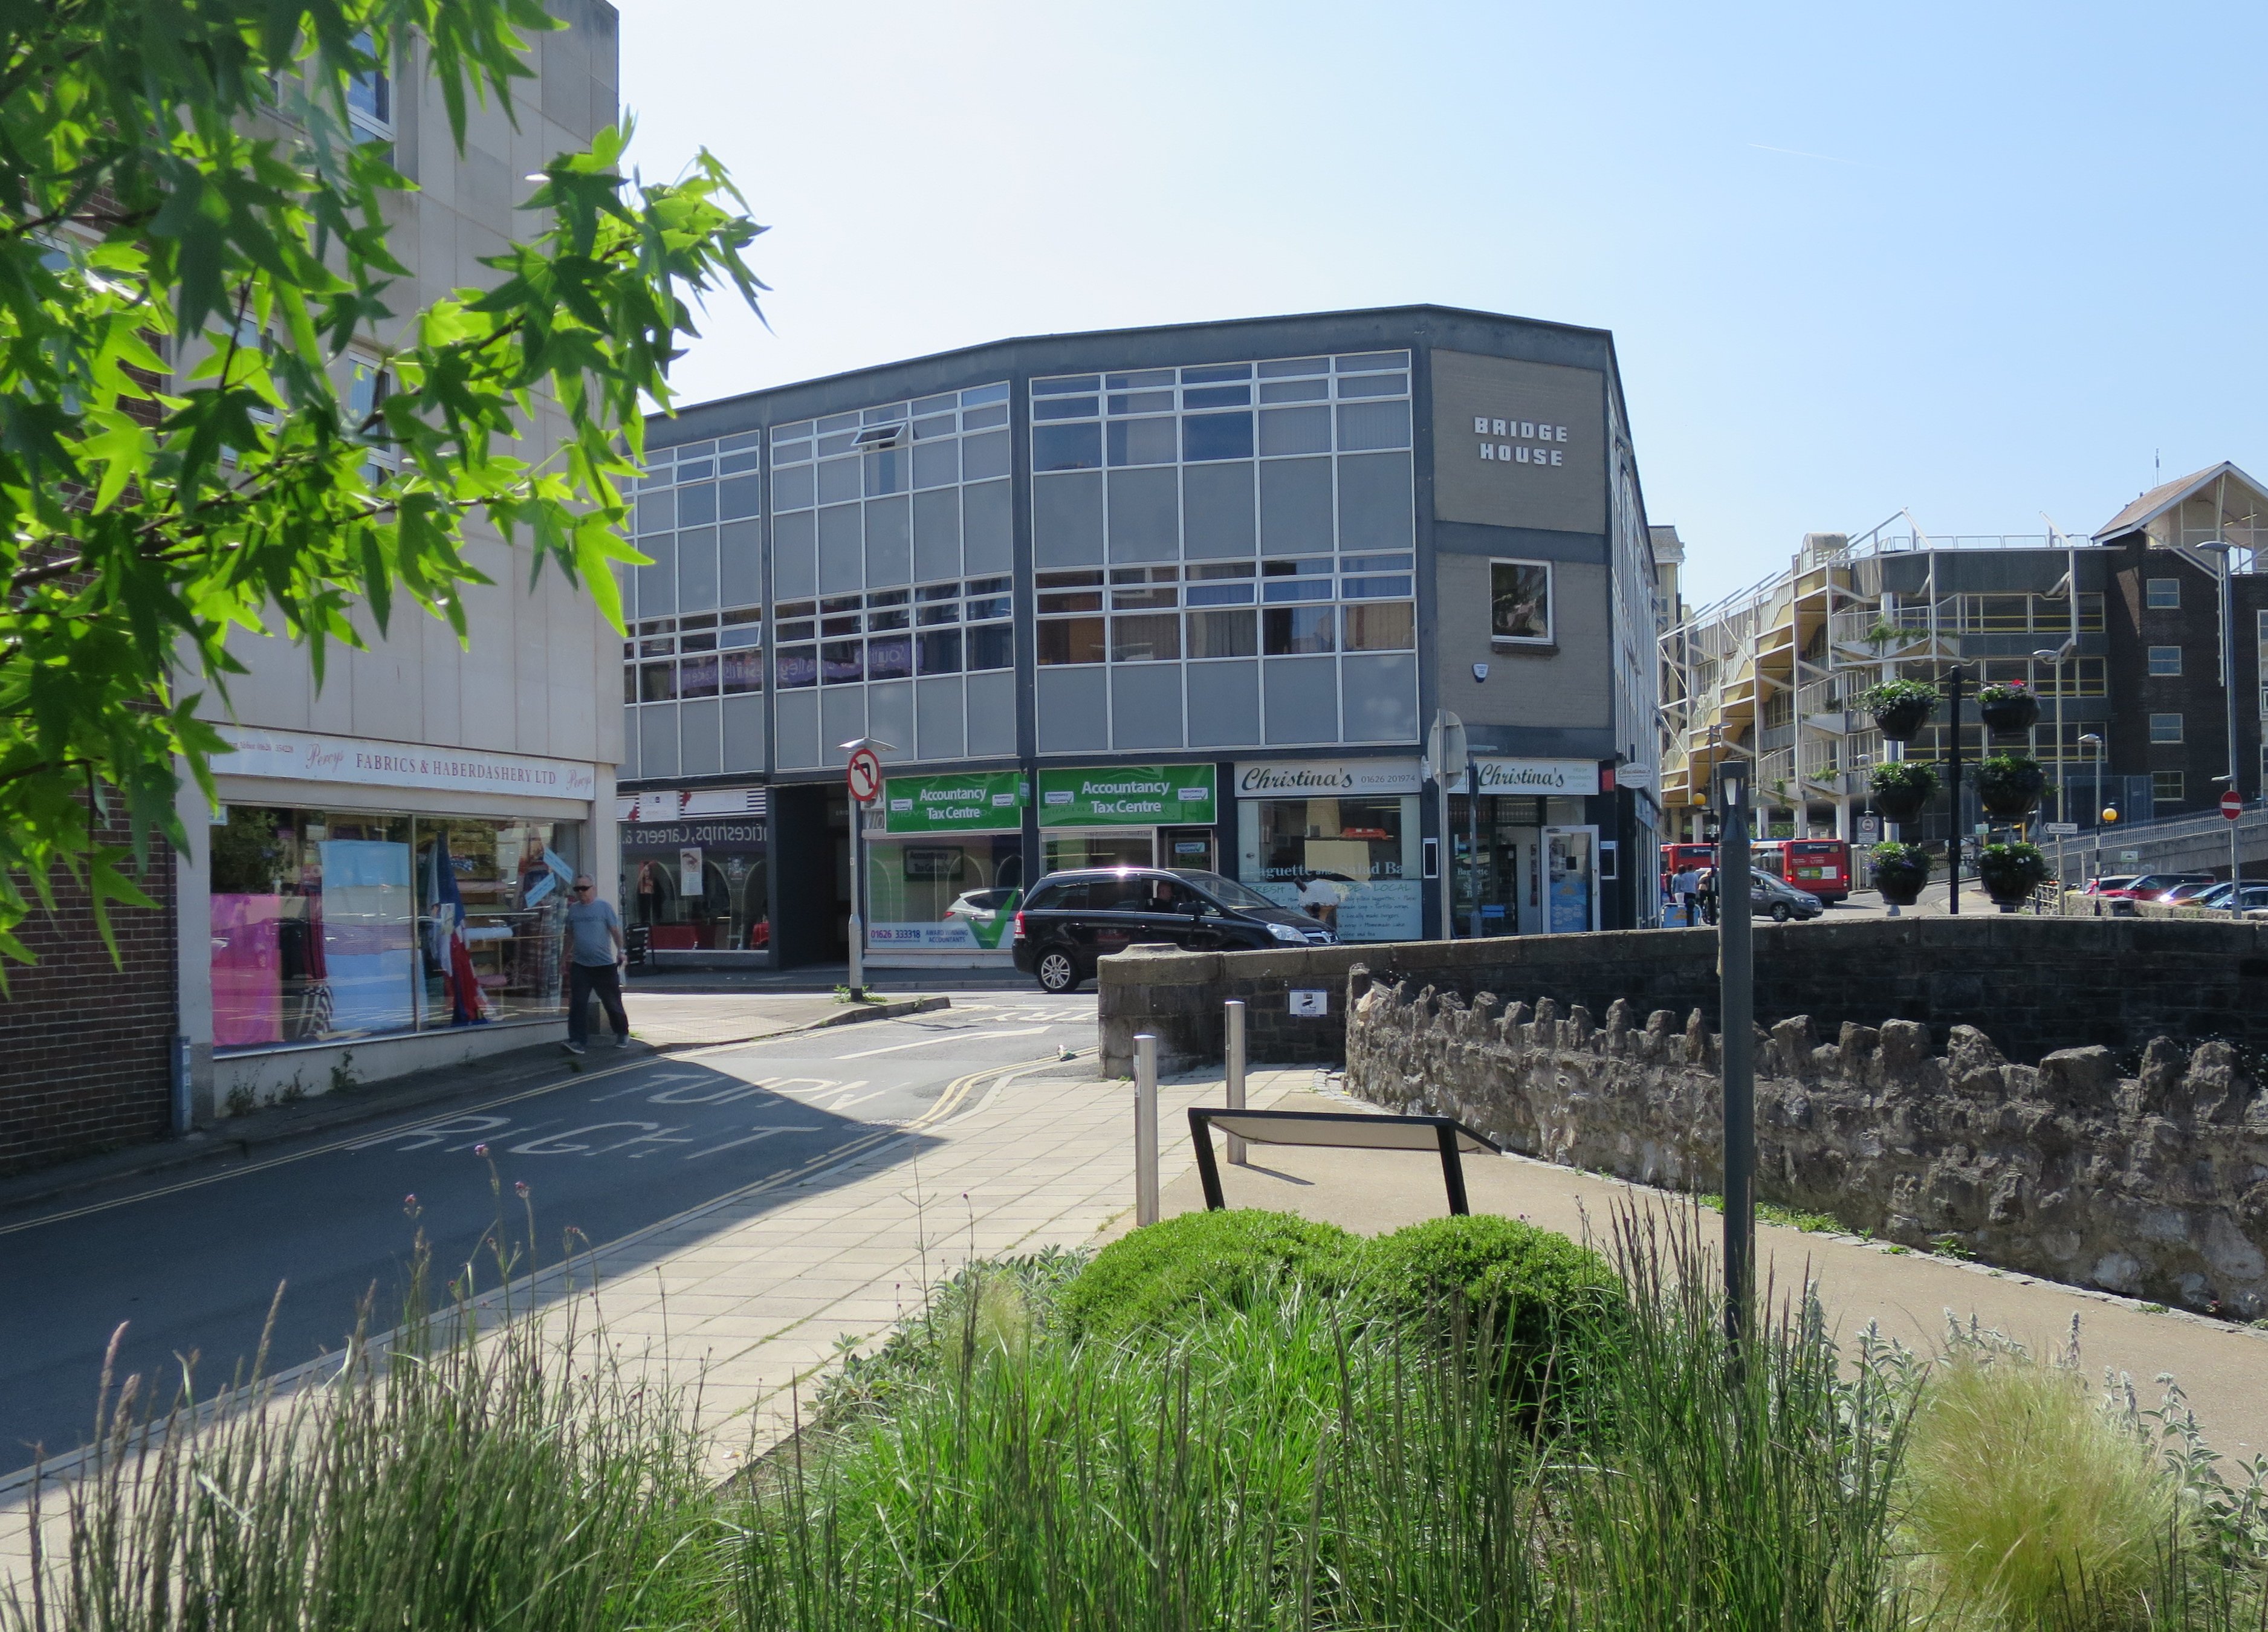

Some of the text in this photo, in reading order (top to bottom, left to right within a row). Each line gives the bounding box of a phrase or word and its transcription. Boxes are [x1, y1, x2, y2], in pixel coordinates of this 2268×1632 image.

[1474, 416, 1567, 442] BRIDGE
[1480, 442, 1563, 466] HOUSE
[357, 753, 416, 772] FABRICS
[420, 760, 429, 774] &
[433, 761, 531, 782] HABERDASHERY
[535, 771, 556, 784] LTD
[1479, 763, 1564, 787] Christina's
[1081, 780, 1170, 796] Accountancy
[1241, 768, 1353, 791] Christina's
[1387, 774, 1416, 783] 201974
[919, 788, 987, 801] Accountancy
[927, 806, 980, 820] Tax Centre
[1090, 800, 1162, 814] Tax Centre
[1259, 864, 1313, 879] aguette
[1385, 861, 1404, 875] Ba
[1457, 867, 1489, 877] Bagtte
[1373, 884, 1412, 892] LOCAL
[870, 930, 892, 939] 01626
[895, 930, 921, 938] 333318
[589, 1074, 910, 1111] TURN
[345, 1116, 823, 1159] RIGHT
